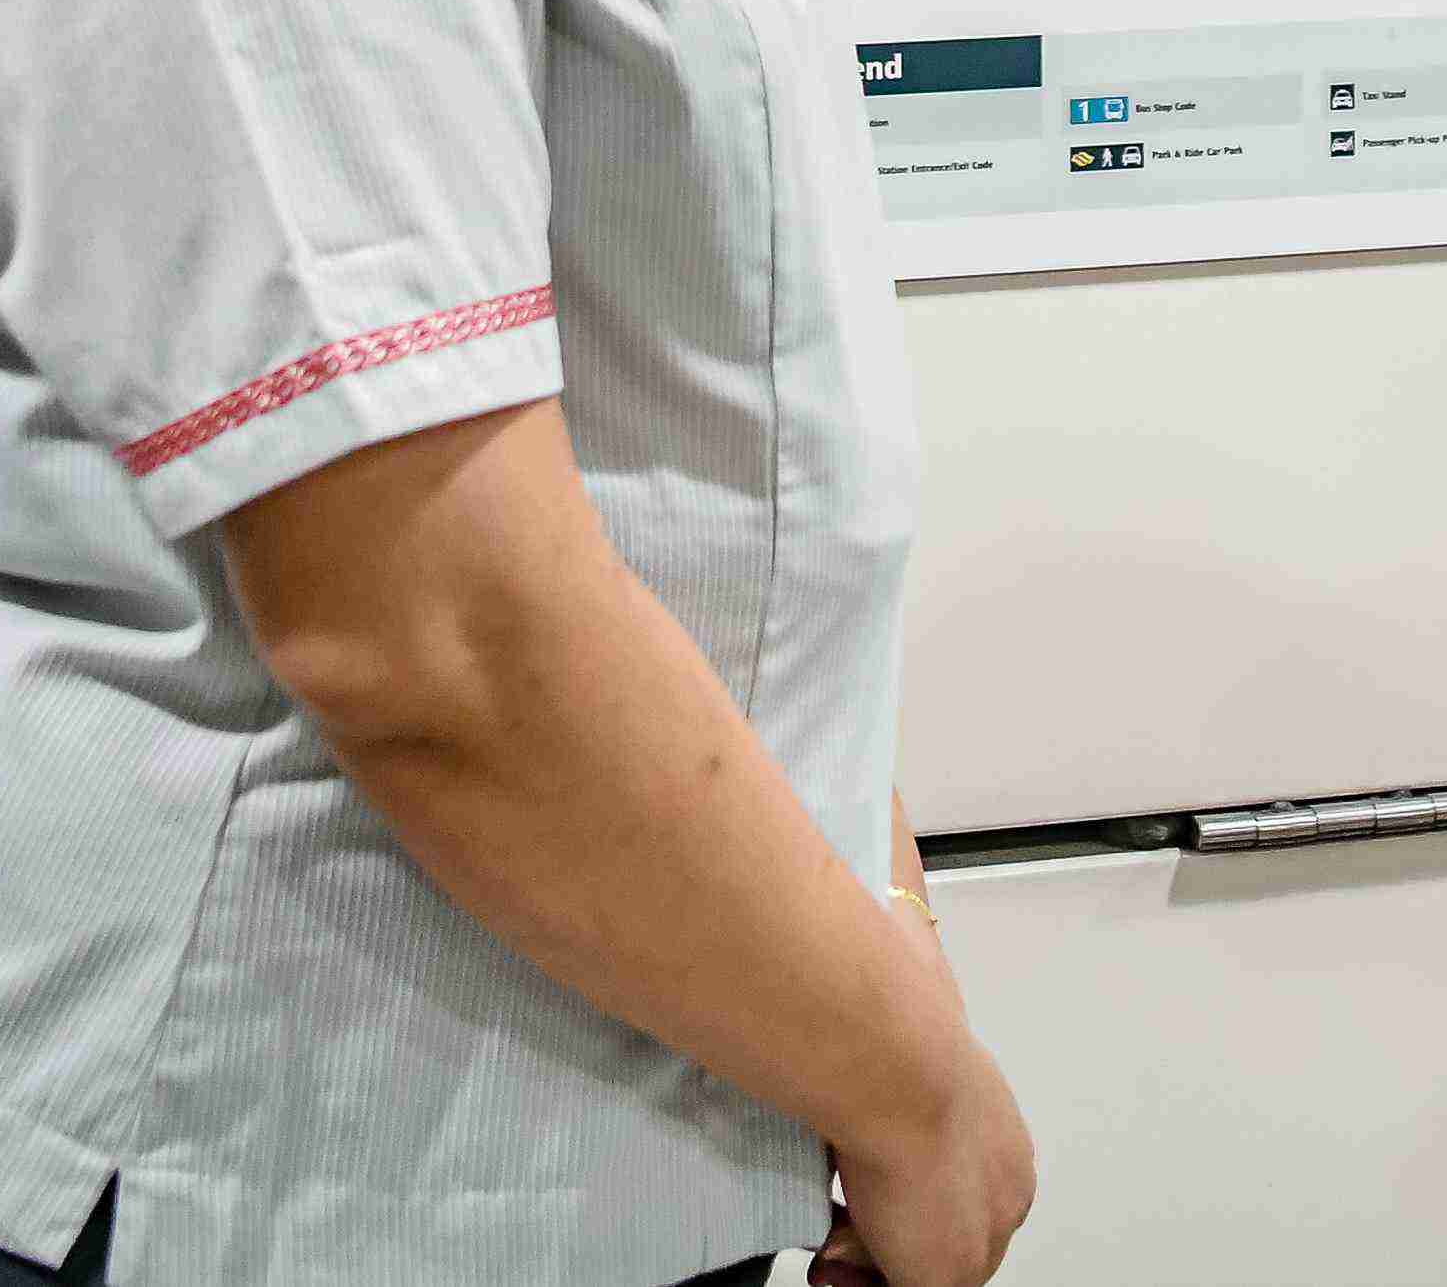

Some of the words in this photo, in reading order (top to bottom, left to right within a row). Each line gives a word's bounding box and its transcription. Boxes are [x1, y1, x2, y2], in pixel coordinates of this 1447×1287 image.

[855, 53, 902, 80] end
[1077, 101, 1089, 122] 1
[1136, 103, 1150, 114] Bus
[1153, 103, 1173, 114] Stop
[1175, 101, 1196, 111] Code
[1363, 137, 1405, 150] Passenger
[1408, 135, 1440, 147] Pick-up
[1152, 149, 1172, 160] Park
[1175, 149, 1182, 158] &
[1185, 147, 1204, 158] Ride
[1207, 147, 1222, 157] Car
[1224, 145, 1243, 156] Park
[878, 166, 908, 175] Station
[912, 162, 969, 173] Entrance/Exit
[972, 161, 993, 169] Code
